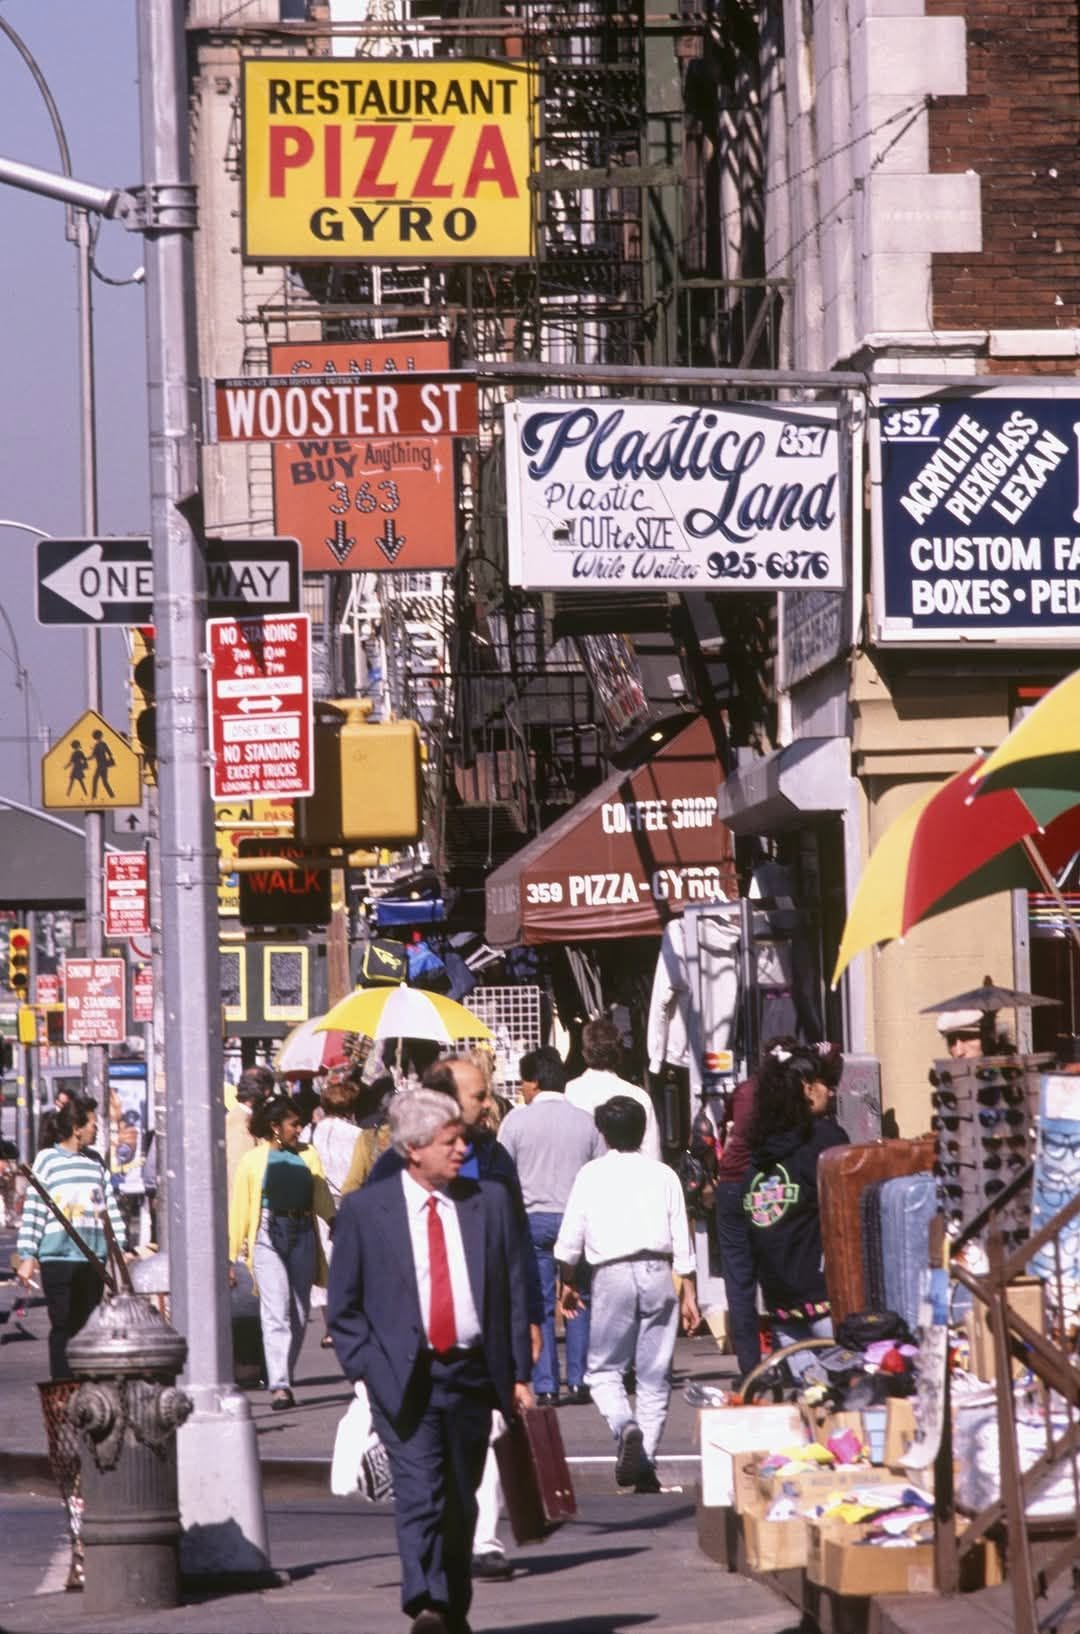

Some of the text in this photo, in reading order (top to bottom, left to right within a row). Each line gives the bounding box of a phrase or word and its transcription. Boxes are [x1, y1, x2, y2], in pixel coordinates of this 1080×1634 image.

[268, 79, 518, 115] RESTAURANT
[269, 125, 520, 198] PIZZA
[309, 207, 478, 242] GYRO
[225, 383, 462, 438] WOOSTER ST
[884, 407, 941, 436] 357
[299, 441, 352, 458] WE
[520, 406, 742, 481] Plastic
[781, 425, 824, 457] 357
[291, 443, 433, 485] BUY Anything
[900, 414, 990, 526] ACRYLITE
[944, 410, 1039, 526] PLEXIGLASS
[991, 430, 1070, 526] LEXAN
[329, 480, 400, 515] 363
[544, 482, 655, 512] Plastic
[684, 430, 838, 544] Land
[635, 517, 675, 550] SIZE
[706, 551, 830, 579] 925-6376
[910, 536, 1042, 572] CUSTOM
[80, 566, 280, 598] ONE WAY
[911, 579, 1011, 615] BOXES
[219, 623, 298, 645] NO STANDING
[223, 741, 300, 763] NO STANDING
[226, 762, 298, 780] EXCEPT TRUCKS
[601, 797, 718, 834] COFFEE SHOP
[247, 867, 321, 895] WALK
[527, 883, 563, 904] 359
